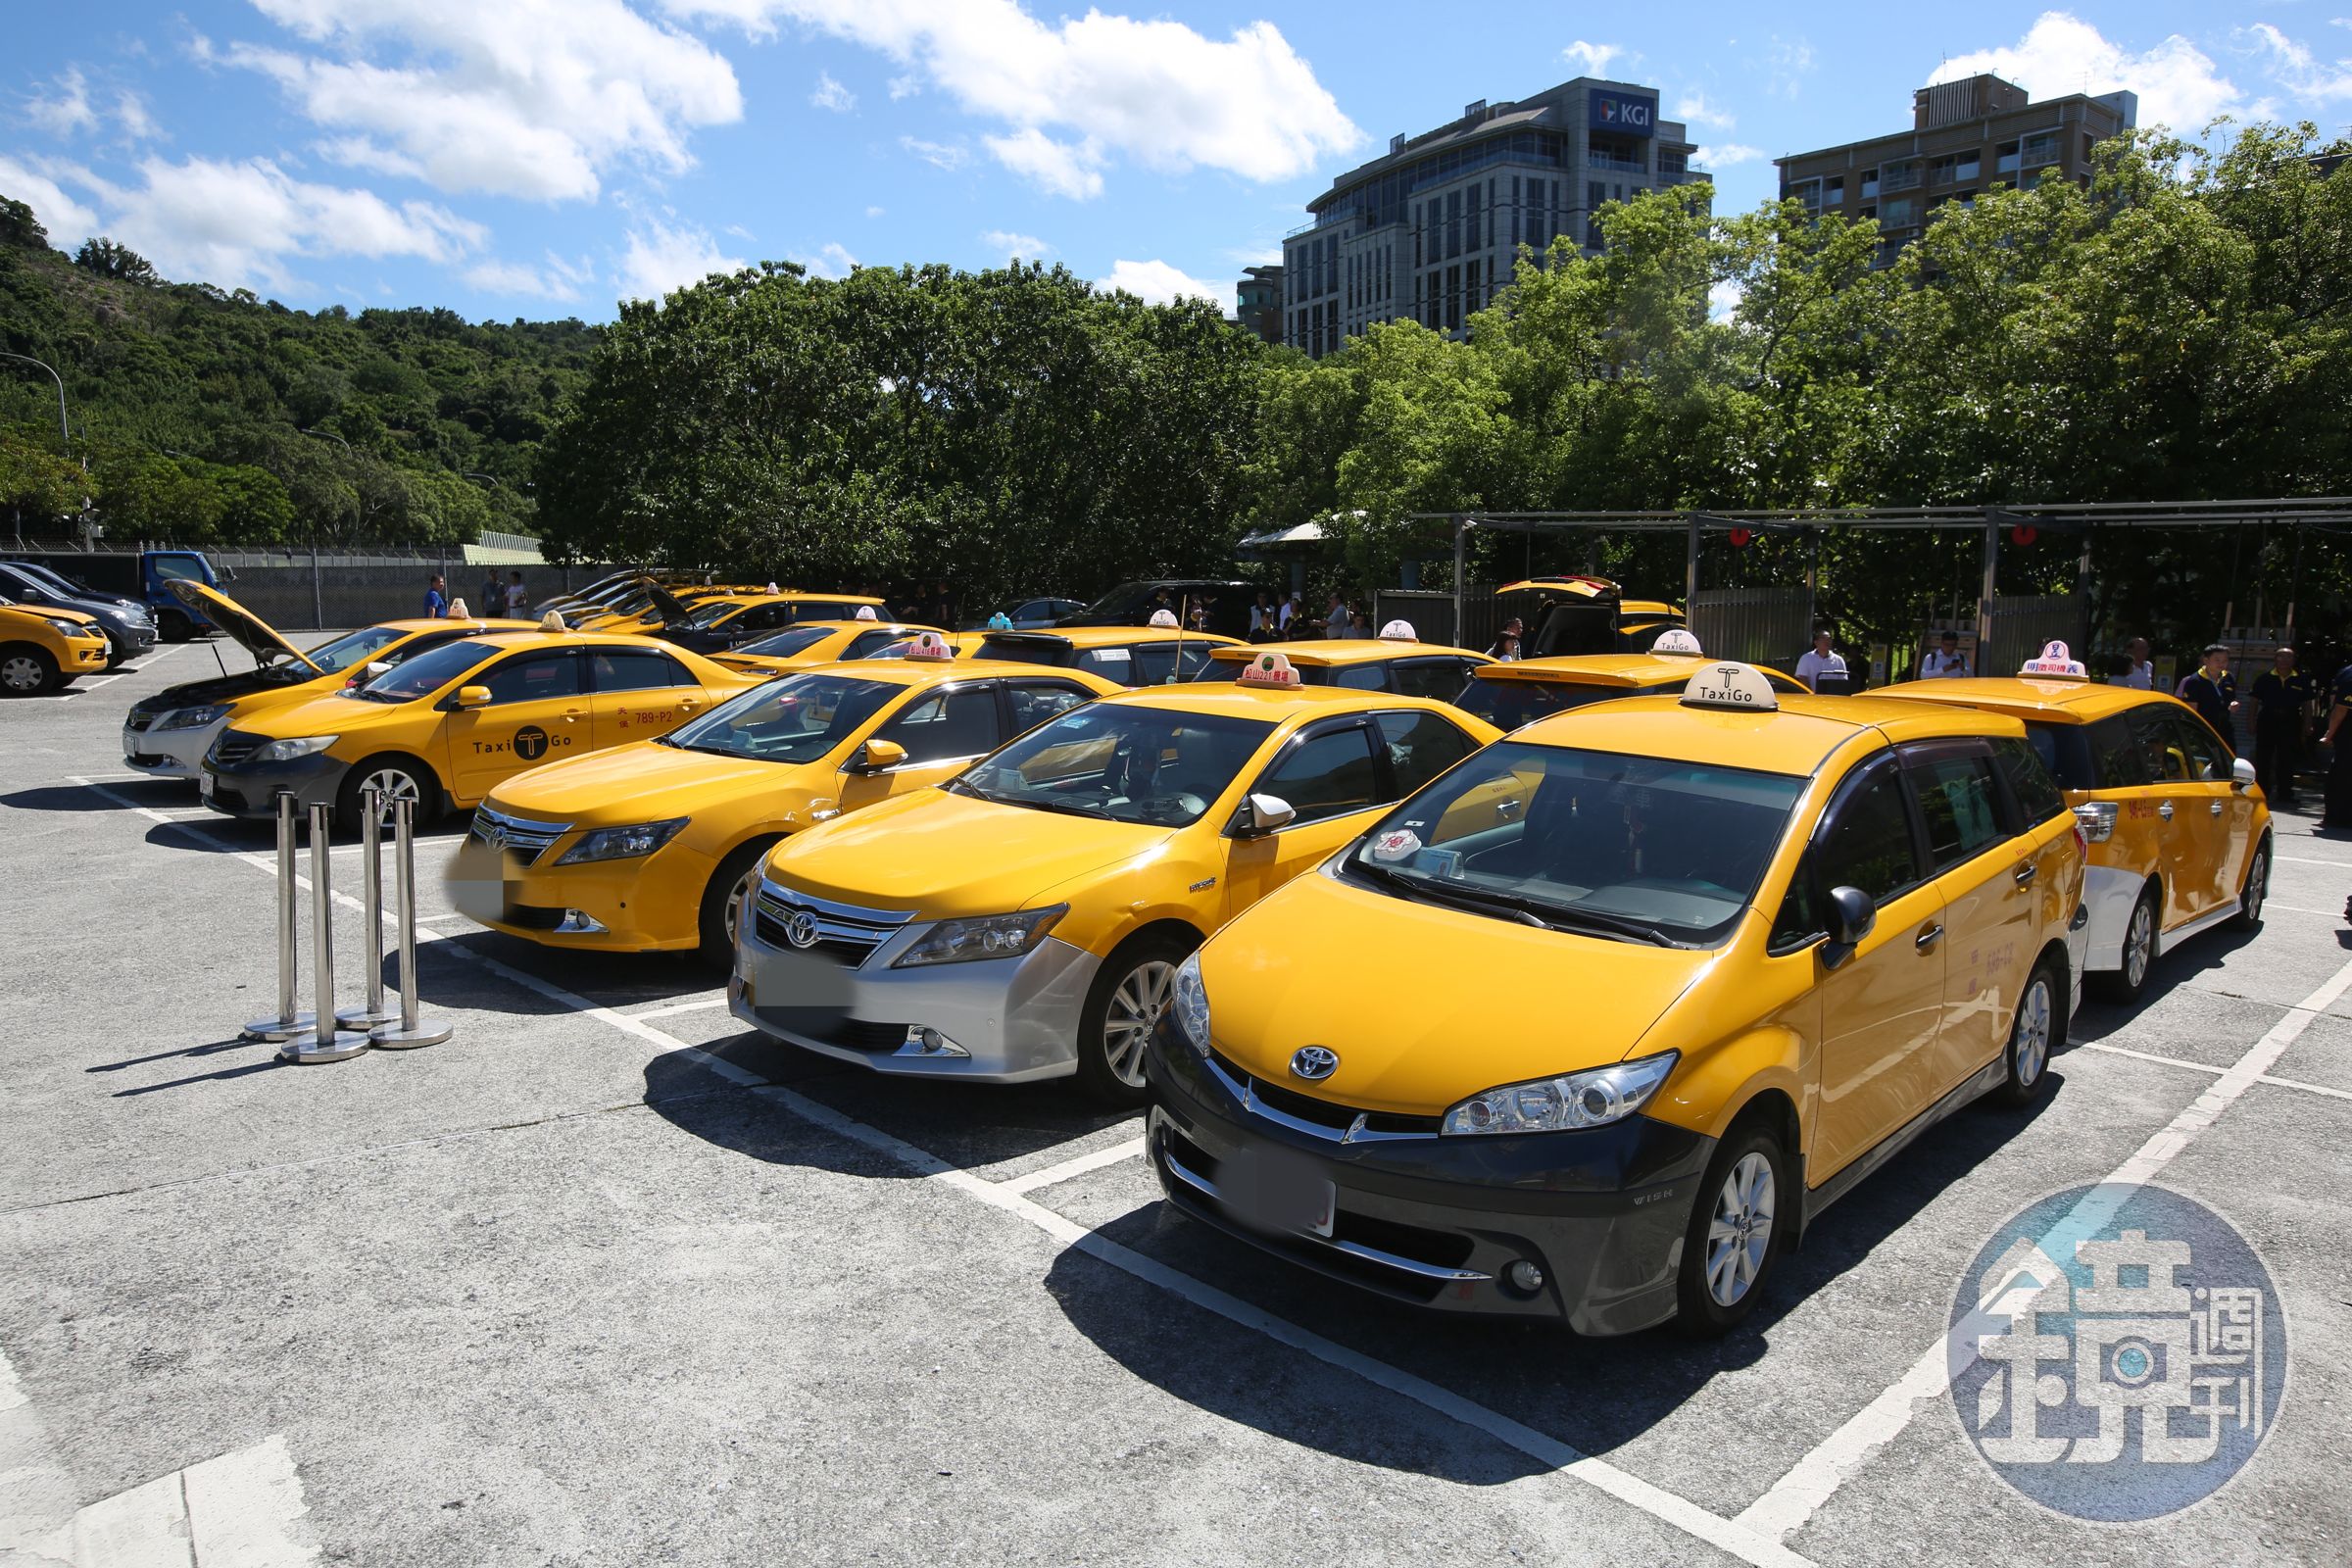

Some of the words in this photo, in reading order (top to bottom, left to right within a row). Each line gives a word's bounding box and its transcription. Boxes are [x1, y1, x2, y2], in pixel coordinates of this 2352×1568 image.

[1621, 103, 1649, 126] KGI
[1661, 642, 1690, 651] TaxiGo
[1699, 686, 1753, 703] TaxiGo
[635, 710, 673, 725] 789-P2
[472, 739, 512, 755] Taxi
[551, 734, 572, 748] Go
[1632, 1188, 1674, 1206] WISH
